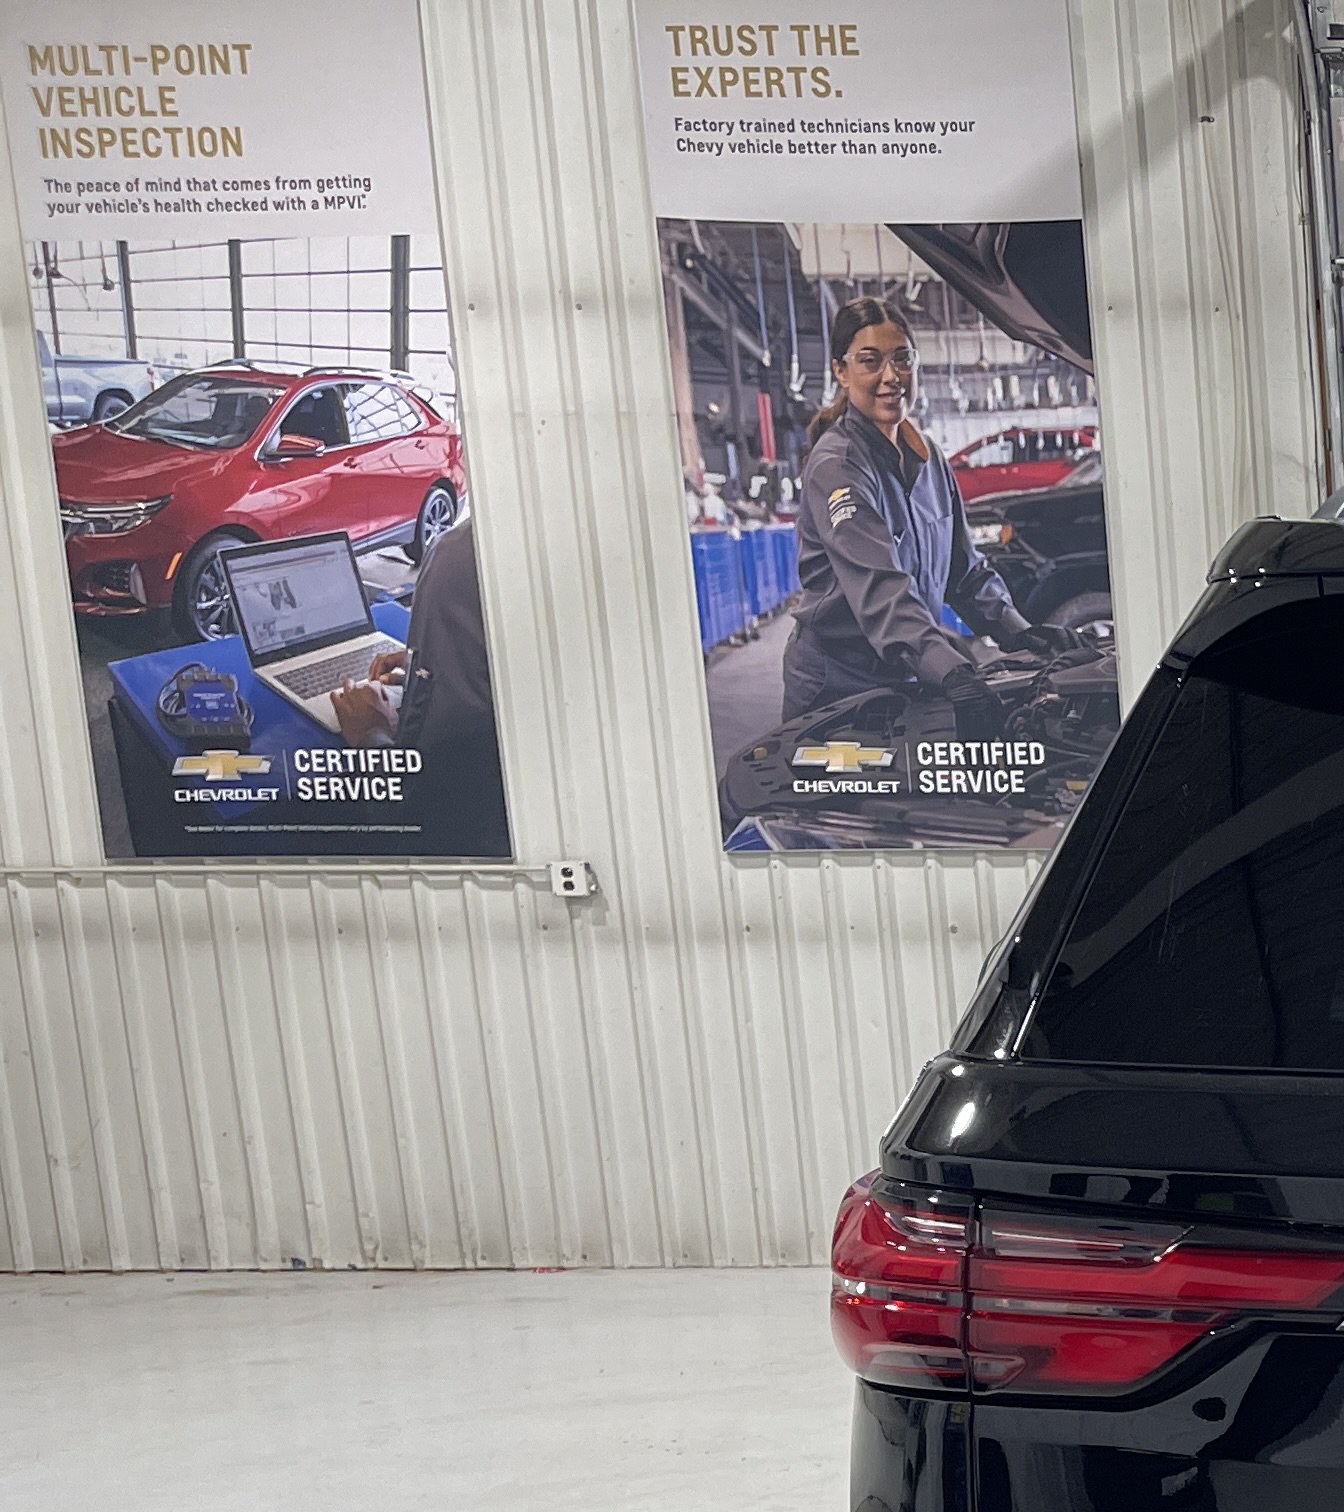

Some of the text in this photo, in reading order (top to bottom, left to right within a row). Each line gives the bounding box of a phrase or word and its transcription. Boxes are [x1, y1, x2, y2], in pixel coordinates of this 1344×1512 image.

[665, 24, 860, 57] TRUST THE
[28, 43, 252, 77] MULTI-POINT
[670, 66, 844, 98] EXPERTS.
[32, 86, 179, 117] VEHICLE
[674, 117, 976, 136] Factory trained technicians know your
[39, 126, 243, 158] INSPECTION
[676, 138, 942, 157] Chevy vehicle better than anyone.
[44, 175, 372, 196] The peace of mind that comes from getting
[47, 201, 81, 217] your
[85, 199, 150, 214] vehicle's
[154, 198, 201, 214] health
[206, 197, 268, 213] checked
[272, 196, 306, 211] with
[311, 199, 319, 210] a
[294, 748, 422, 774] CERTIFIED
[917, 742, 1046, 766] CERTIFIED
[297, 776, 404, 801] SERVICE
[792, 779, 900, 794] CHEVROLET
[919, 769, 1025, 794] SERVICE
[174, 787, 280, 803] CHEVROLET
